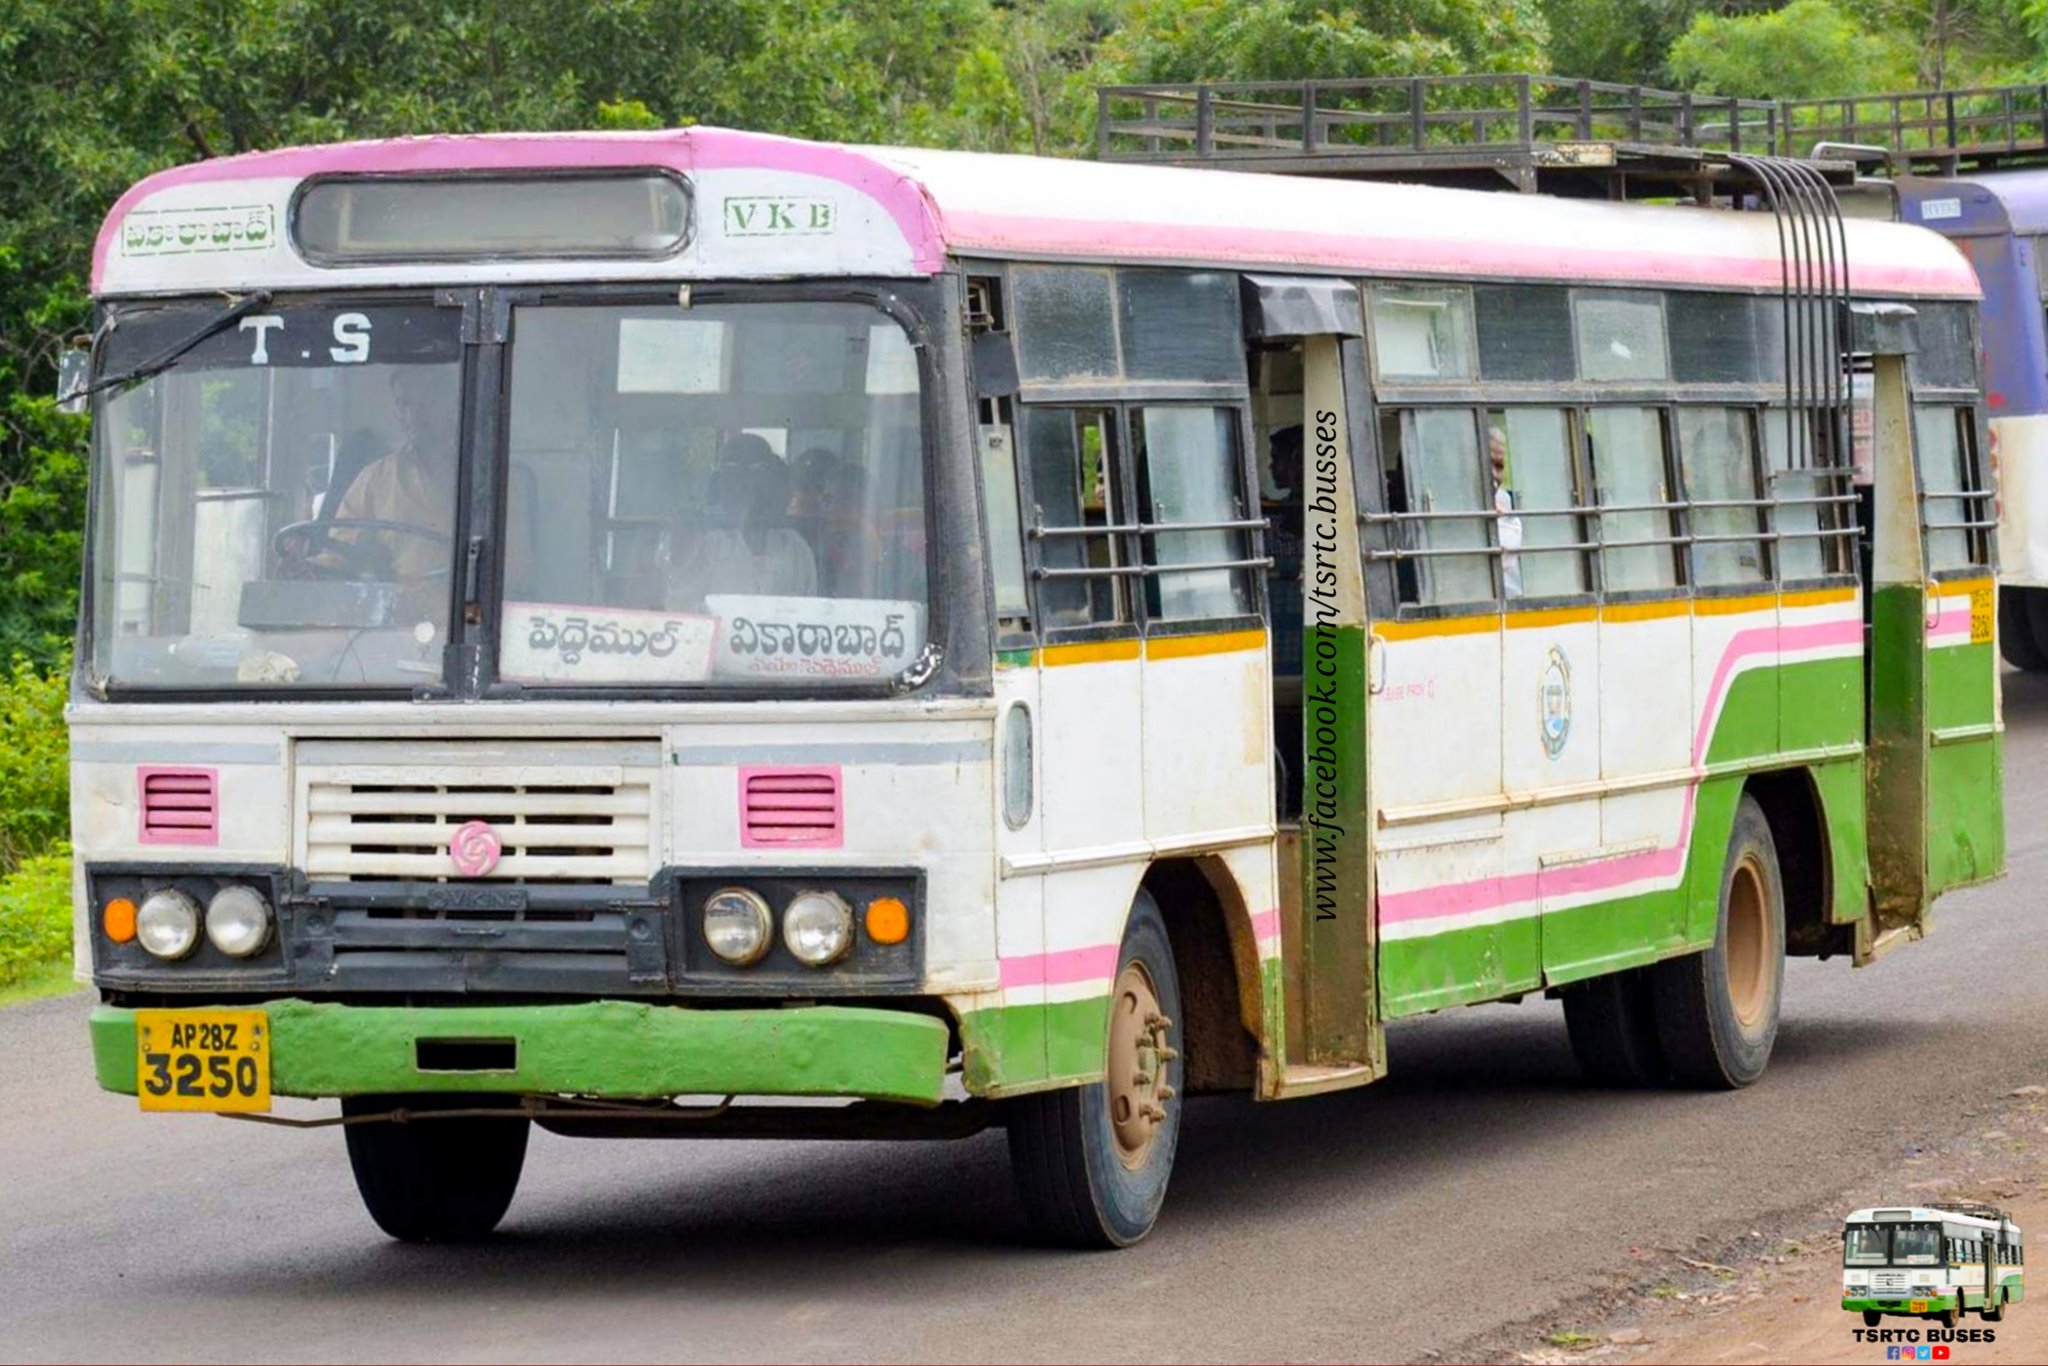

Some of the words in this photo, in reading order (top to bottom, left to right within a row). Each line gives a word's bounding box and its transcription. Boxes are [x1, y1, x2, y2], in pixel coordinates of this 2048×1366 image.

[731, 203, 831, 230] VKB
[729, 614, 905, 659] వికారాబాద్
[144, 1053, 258, 1098] 3250
